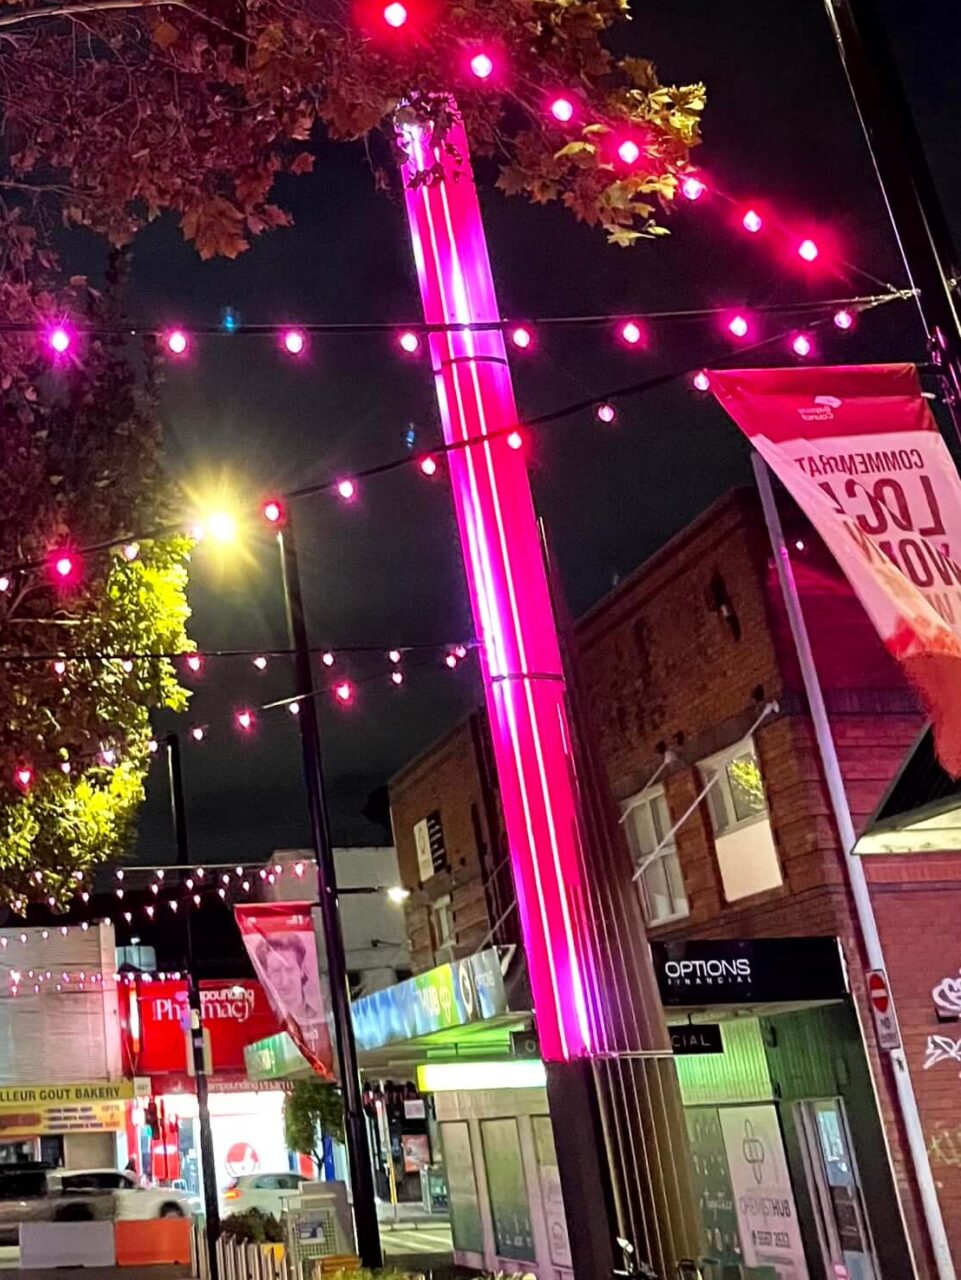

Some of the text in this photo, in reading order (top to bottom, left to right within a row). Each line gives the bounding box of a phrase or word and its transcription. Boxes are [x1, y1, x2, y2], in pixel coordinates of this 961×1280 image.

[664, 958, 751, 977] OPTIONS
[668, 976, 752, 985] FINANCIAL
[40, 1088, 71, 1101] GOUT
[75, 1086, 120, 1100] BAKERY
